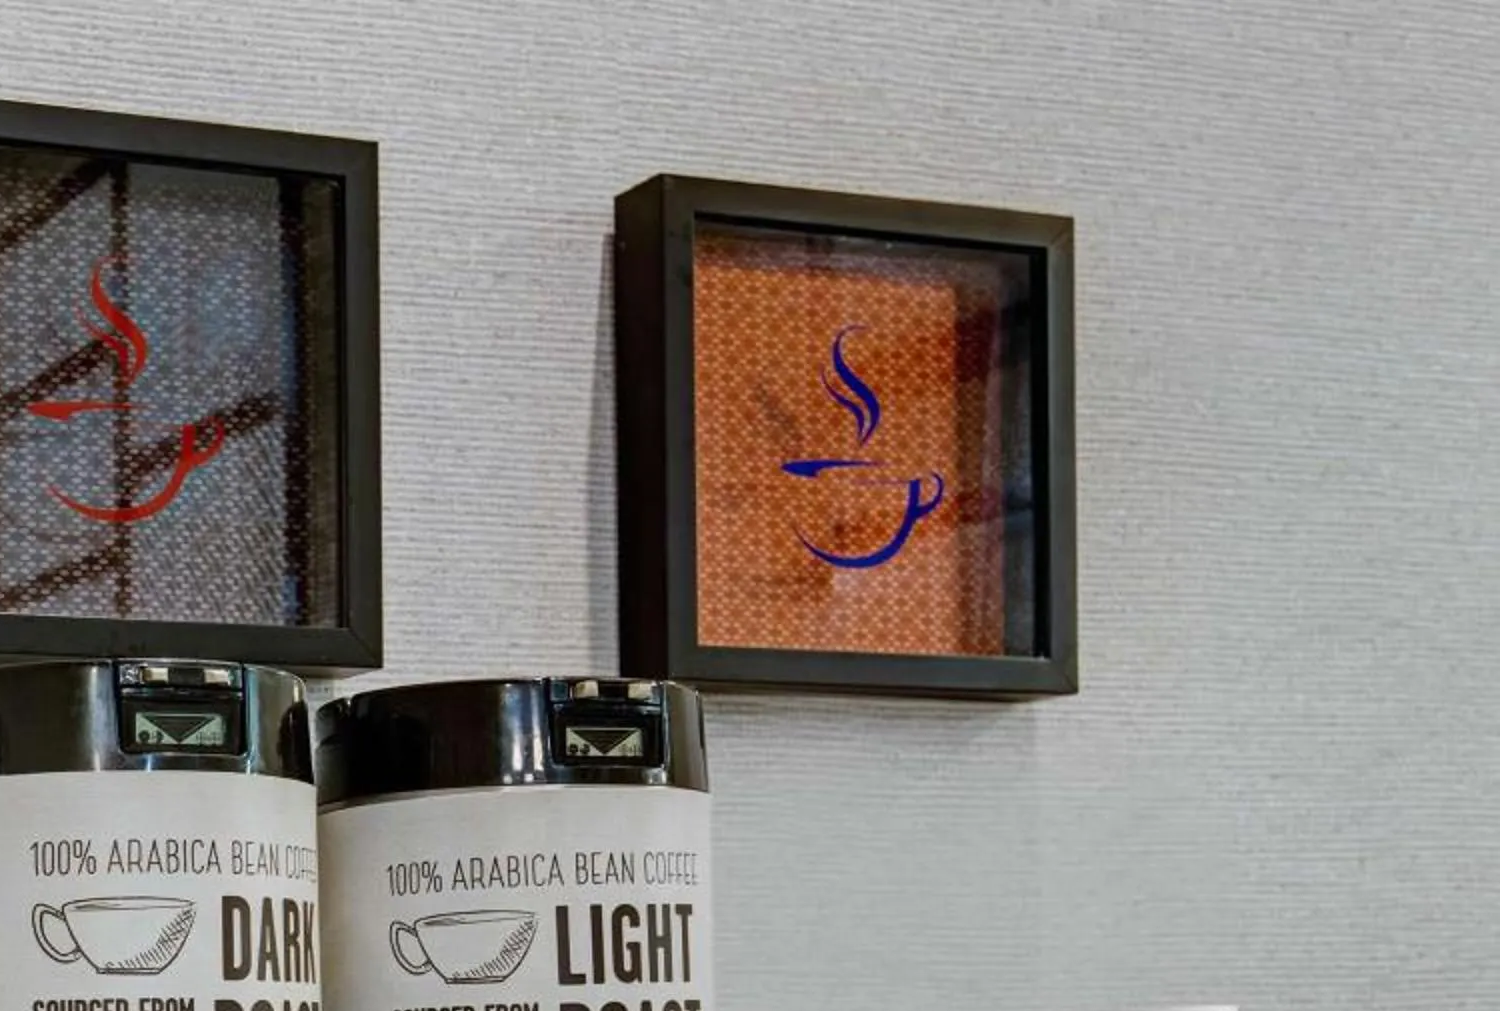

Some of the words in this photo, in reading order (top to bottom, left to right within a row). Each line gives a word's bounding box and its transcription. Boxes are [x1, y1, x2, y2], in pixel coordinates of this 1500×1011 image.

[30, 840, 96, 876] 100%
[108, 839, 221, 874] ARABICA
[232, 840, 279, 876] BEAN
[387, 861, 442, 896] 100%
[452, 854, 564, 890] ARABICA
[576, 852, 634, 885] BEAN
[644, 851, 699, 886] COFFEE
[222, 896, 316, 984] DARK
[556, 904, 692, 985] LIGHT
